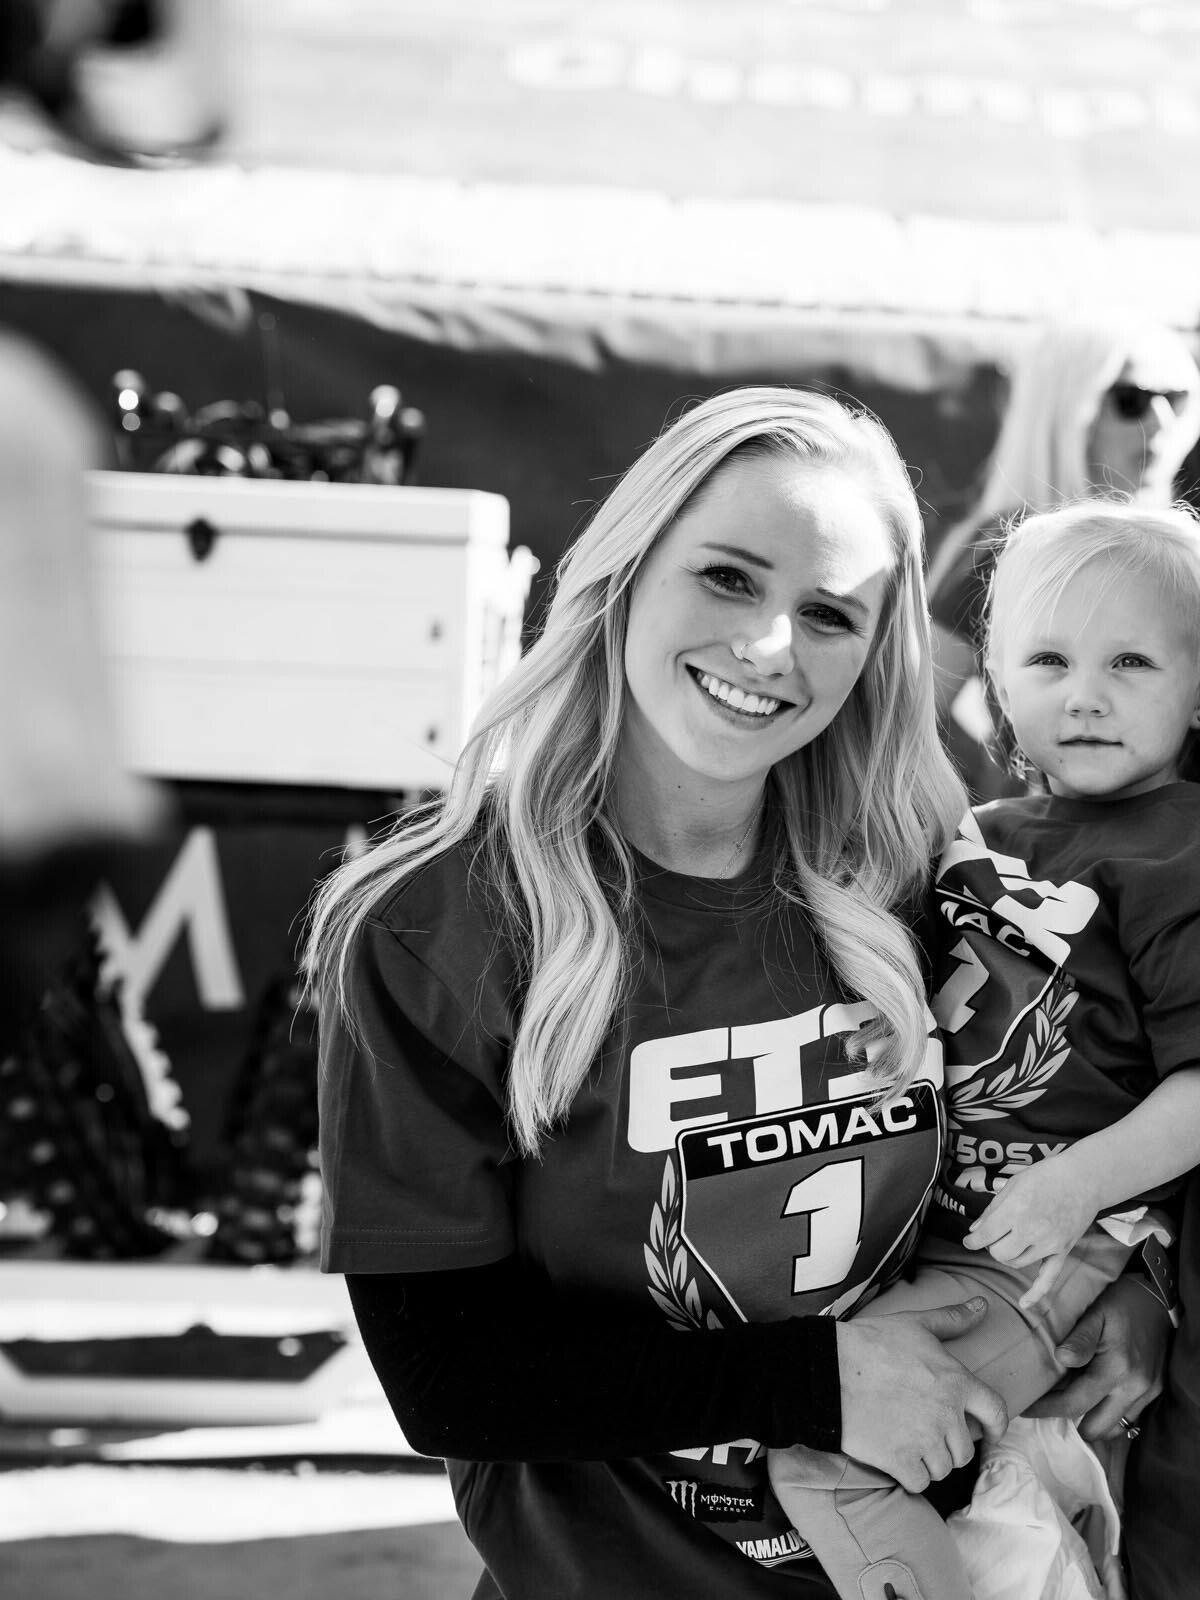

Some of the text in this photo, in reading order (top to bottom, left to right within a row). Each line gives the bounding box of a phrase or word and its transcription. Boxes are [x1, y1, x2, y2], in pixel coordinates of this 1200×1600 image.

[707, 1095, 918, 1169] TOMAC
[781, 1155, 865, 1297] 1
[700, 1493, 755, 1508] MONSTER
[709, 1505, 747, 1514] ENERGY
